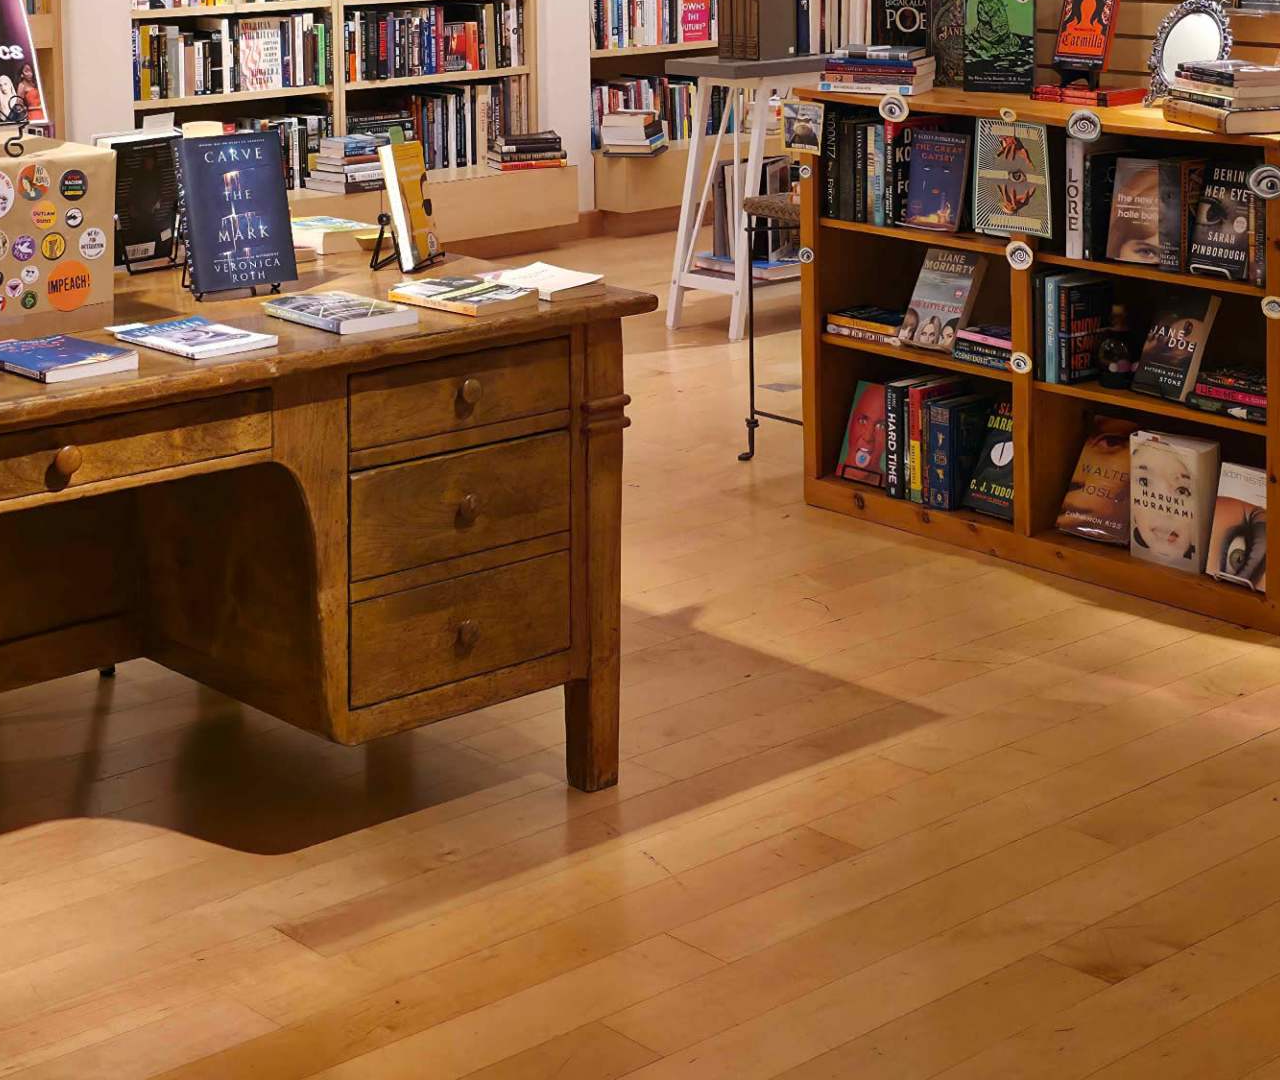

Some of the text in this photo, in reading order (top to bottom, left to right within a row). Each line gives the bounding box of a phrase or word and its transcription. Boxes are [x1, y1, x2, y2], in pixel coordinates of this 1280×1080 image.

[682, 3, 706, 11] OWNS
[885, 5, 927, 33] POE
[938, 24, 964, 41] JANE
[1061, 32, 1103, 50] Carmilla
[204, 146, 264, 164] CARVE
[921, 152, 956, 163] GATSBY
[1213, 167, 1245, 183] BEHIN
[224, 189, 252, 202] THE
[1067, 169, 1081, 233] LORE
[1117, 194, 1132, 203] the
[1205, 185, 1248, 202] HER EYE
[218, 226, 271, 245] MARK
[1207, 231, 1236, 245] SARAH
[938, 252, 967, 266] LIANE
[1191, 243, 1246, 262] PINBOROUGH
[213, 258, 282, 274] VERONICA
[923, 260, 975, 275] MORIARTY
[47, 273, 91, 295] IMPEACH!
[232, 270, 266, 284] ROTH
[1150, 324, 1186, 340] JANE
[1168, 337, 1196, 353] DOE
[1159, 375, 1182, 387] STONE
[988, 415, 1013, 432] DARK
[886, 412, 898, 486] HARD TIME
[1142, 489, 1186, 506] HARUKI
[1132, 497, 1195, 520] MURAKAMI
